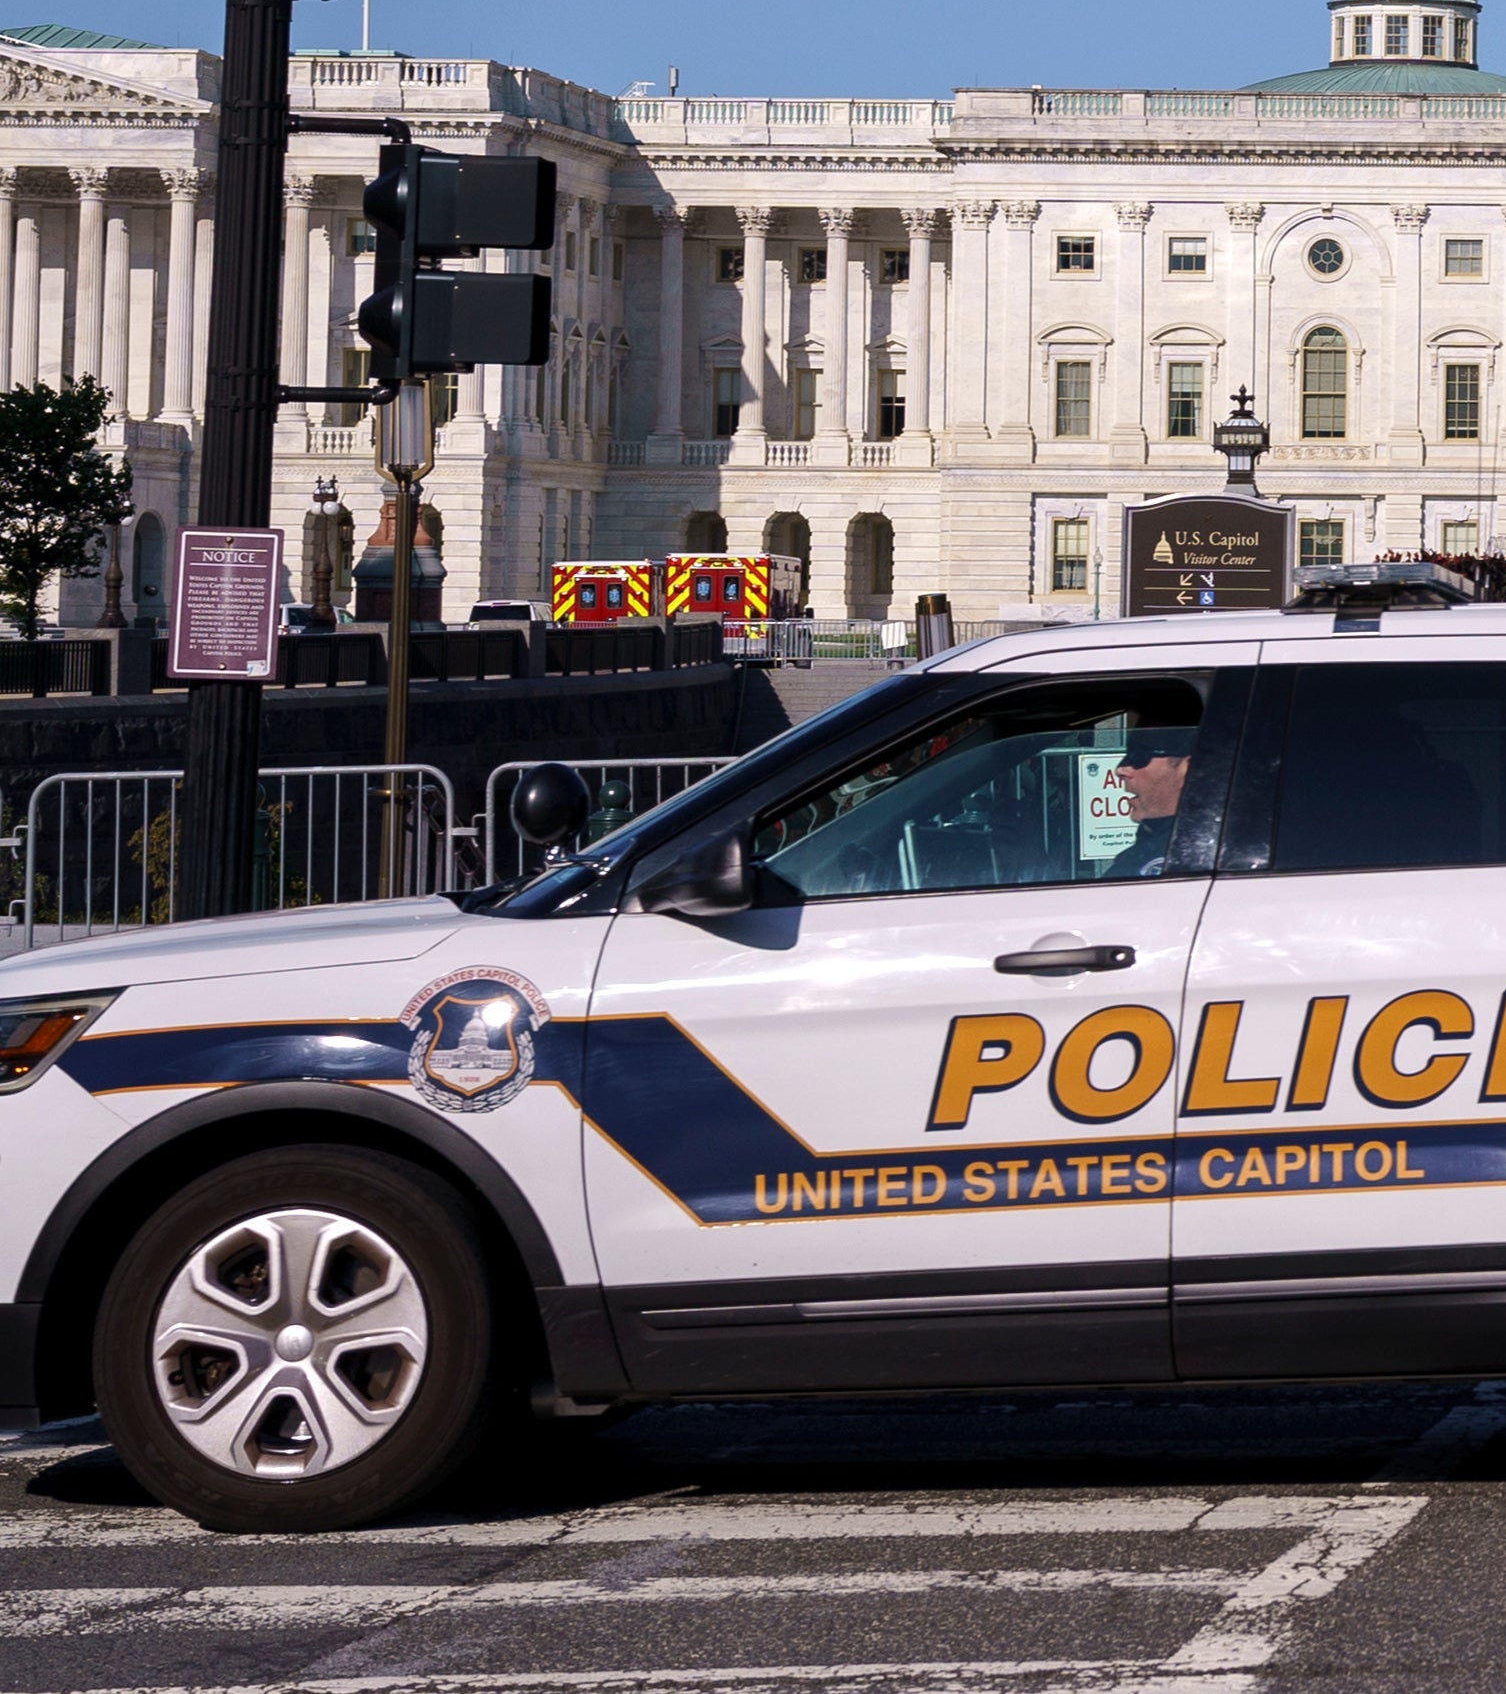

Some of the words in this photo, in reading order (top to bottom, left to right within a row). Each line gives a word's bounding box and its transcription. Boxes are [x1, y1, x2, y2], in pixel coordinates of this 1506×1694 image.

[1175, 531, 1204, 546] U.S.
[1208, 531, 1260, 550] Capitol
[202, 551, 256, 563] NOTICE
[1183, 552, 1218, 565] Visitor
[1220, 552, 1256, 565] Center
[402, 988, 433, 1022] UNITED
[434, 970, 475, 991] STATES
[476, 968, 520, 987] CAPITOL
[520, 983, 549, 1018] POLICE
[753, 1165, 947, 1214] UNITED
[963, 1152, 1168, 1203] STATES
[1200, 1140, 1424, 1189] CAPITOL
